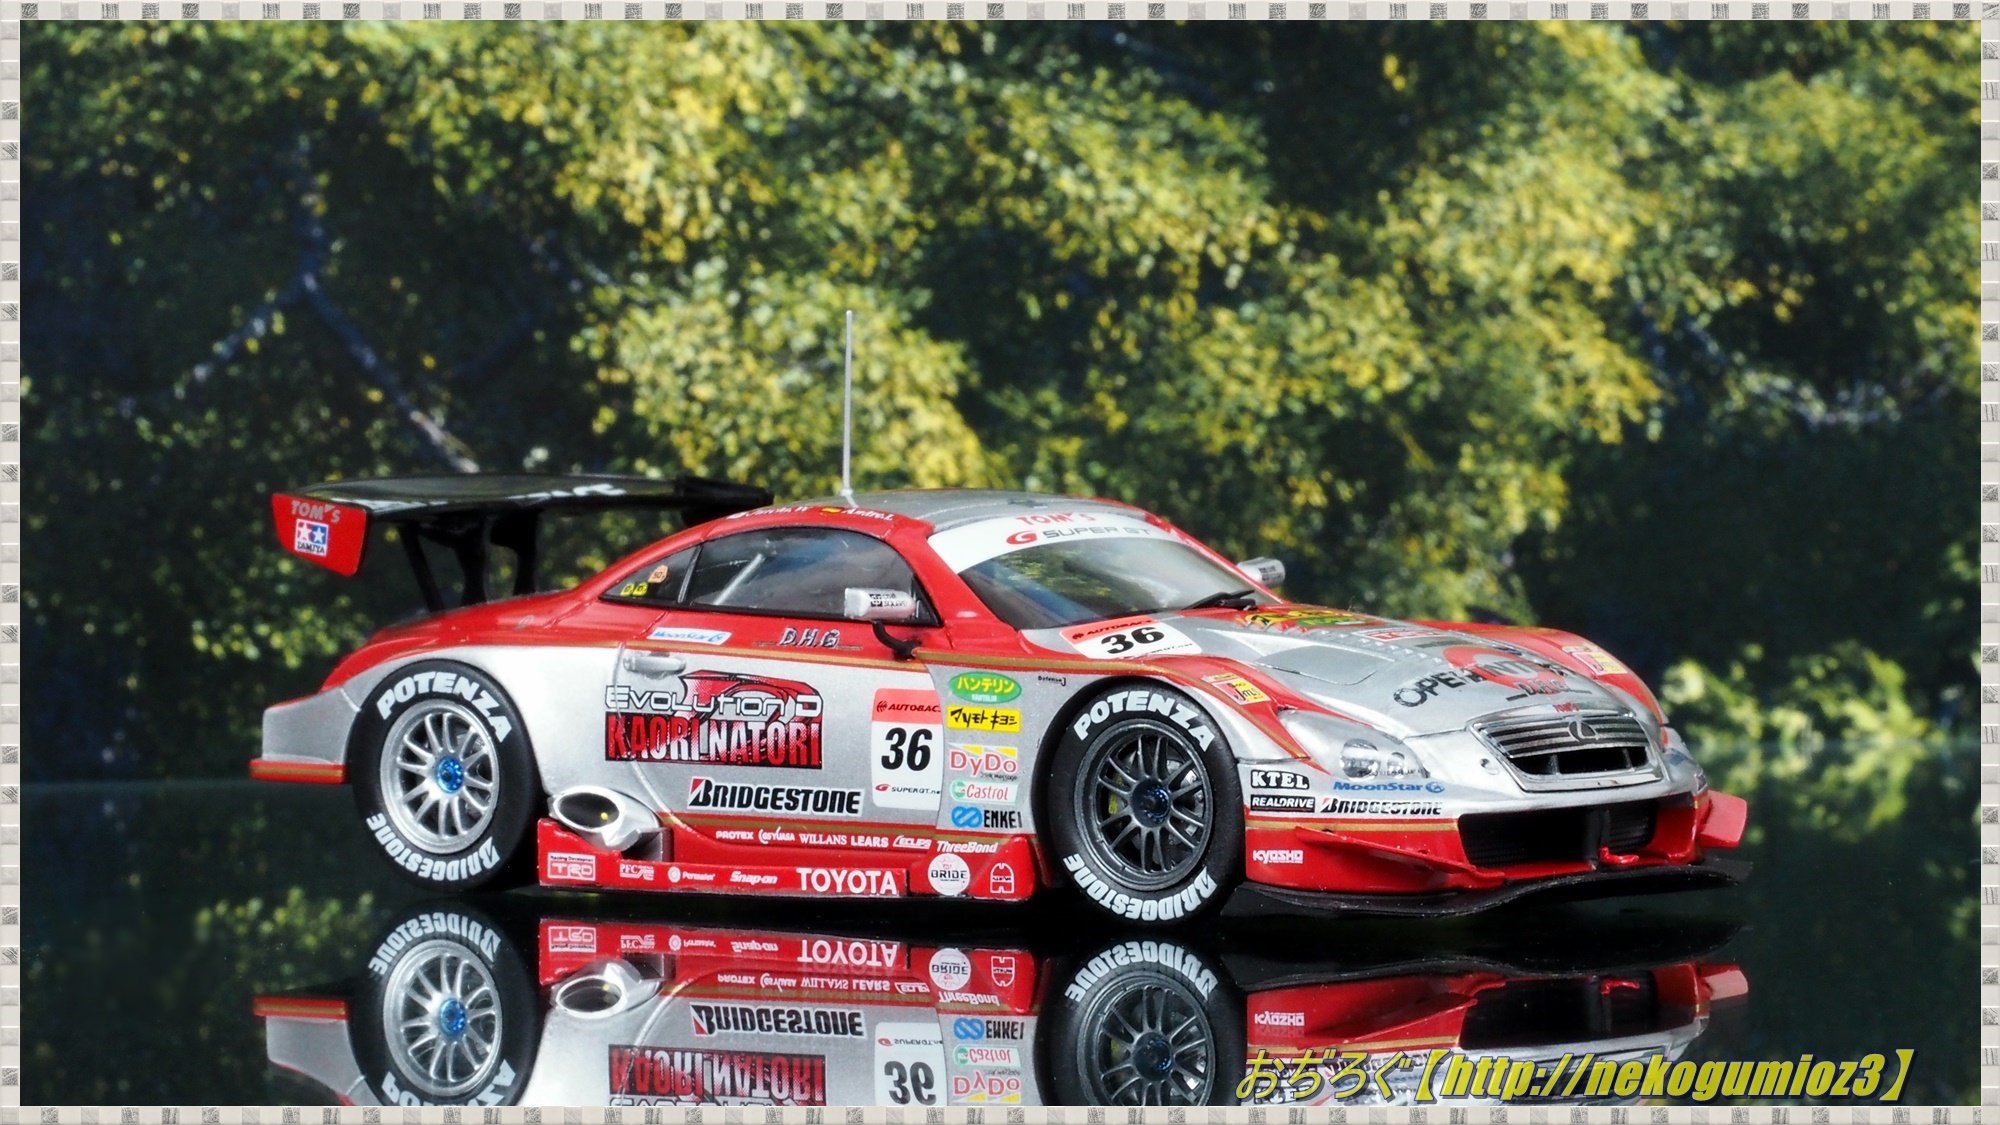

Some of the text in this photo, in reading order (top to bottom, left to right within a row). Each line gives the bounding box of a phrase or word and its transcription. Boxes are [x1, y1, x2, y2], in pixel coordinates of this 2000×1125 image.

[1042, 526, 1119, 539] SUPER
[297, 541, 326, 554] TAMIYA
[1101, 626, 1165, 654] 36
[956, 675, 1016, 694] バンテリン
[376, 671, 513, 743] POTENZA
[795, 694, 823, 718] D
[1073, 690, 1216, 752] POTENZA
[607, 714, 821, 767] KAORI NATORI
[881, 727, 933, 772] 36
[950, 750, 1018, 776] DyDo
[1252, 770, 1309, 790] KTEL
[1333, 781, 1424, 793] MoonStar
[689, 778, 862, 815] BRIDGESTONE
[966, 783, 1009, 801] Castrol
[1252, 797, 1314, 809] REALDRIVE
[1320, 798, 1443, 816] BRIDGESTONE
[983, 809, 1023, 829] ENKEI
[366, 812, 501, 882] BRIDGESTONE
[715, 830, 754, 841] PROTEX
[799, 833, 847, 846] WILLANS
[850, 835, 889, 848] LEARS
[936, 840, 1000, 854] ThreeBond
[551, 862, 594, 879] TRD
[619, 863, 639, 874] PFC
[730, 870, 779, 886] Snap-on
[931, 869, 968, 880] BRIDE
[796, 867, 898, 896] TOYOTA
[1063, 853, 1218, 922] BRIDGESTONE
